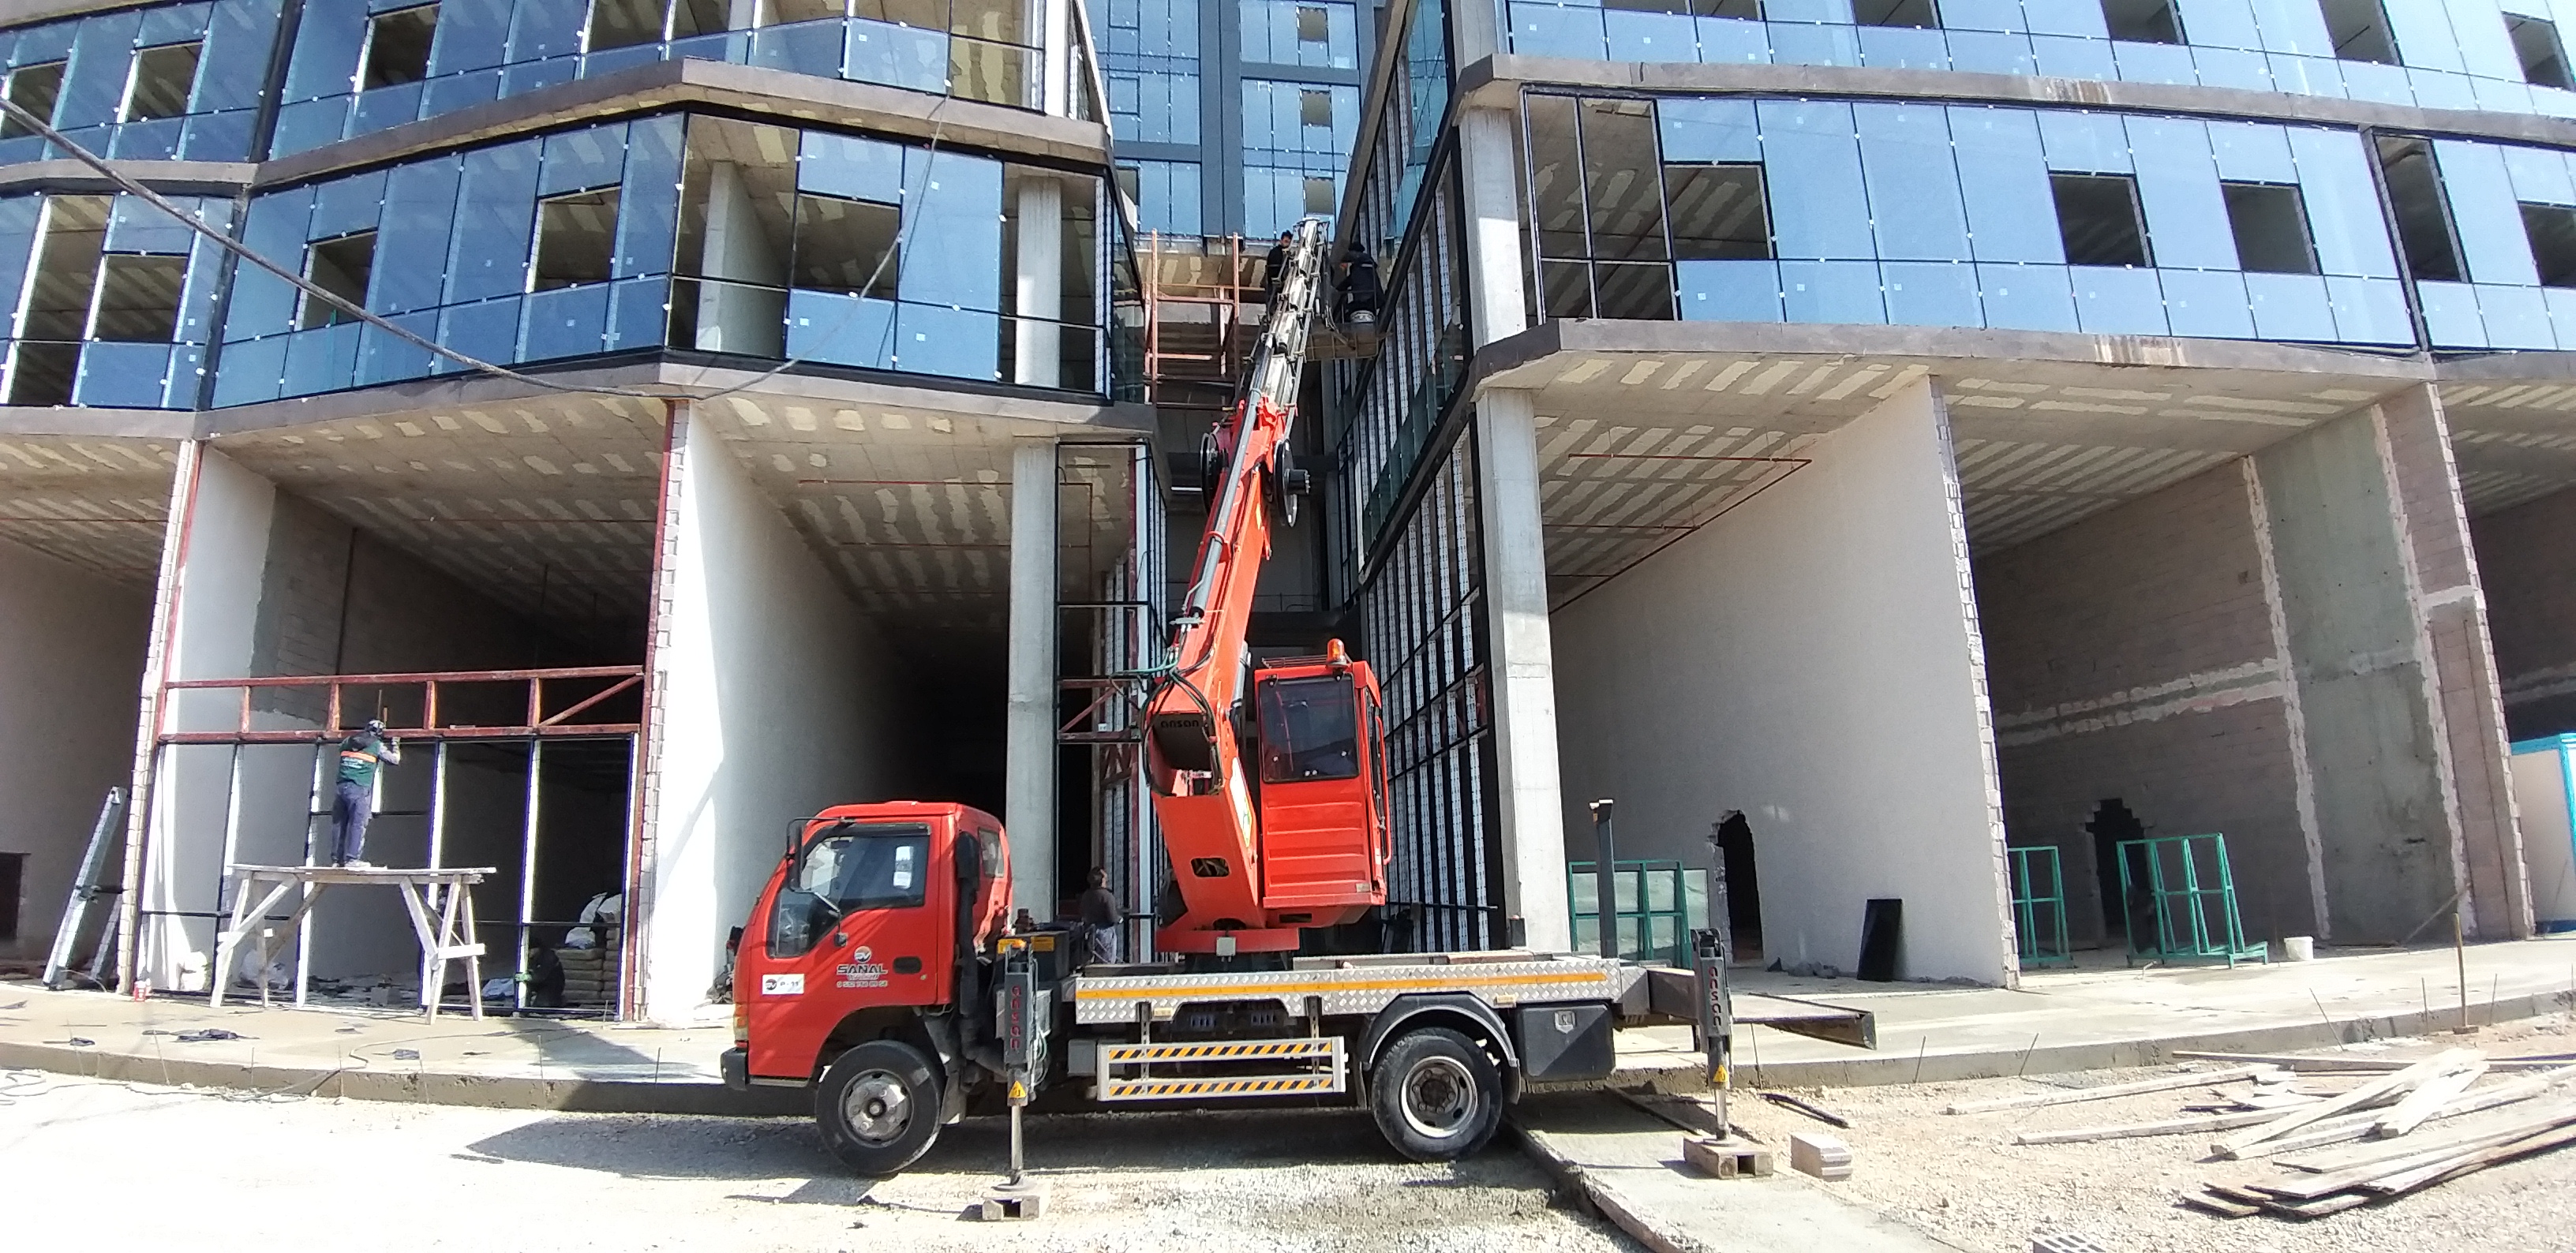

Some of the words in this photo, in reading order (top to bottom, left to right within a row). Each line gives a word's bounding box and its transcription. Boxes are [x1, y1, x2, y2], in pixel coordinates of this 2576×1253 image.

[837, 963, 888, 975] SANAL
[1709, 967, 1722, 1027] ansan
[1010, 986, 1021, 1049] ansan
